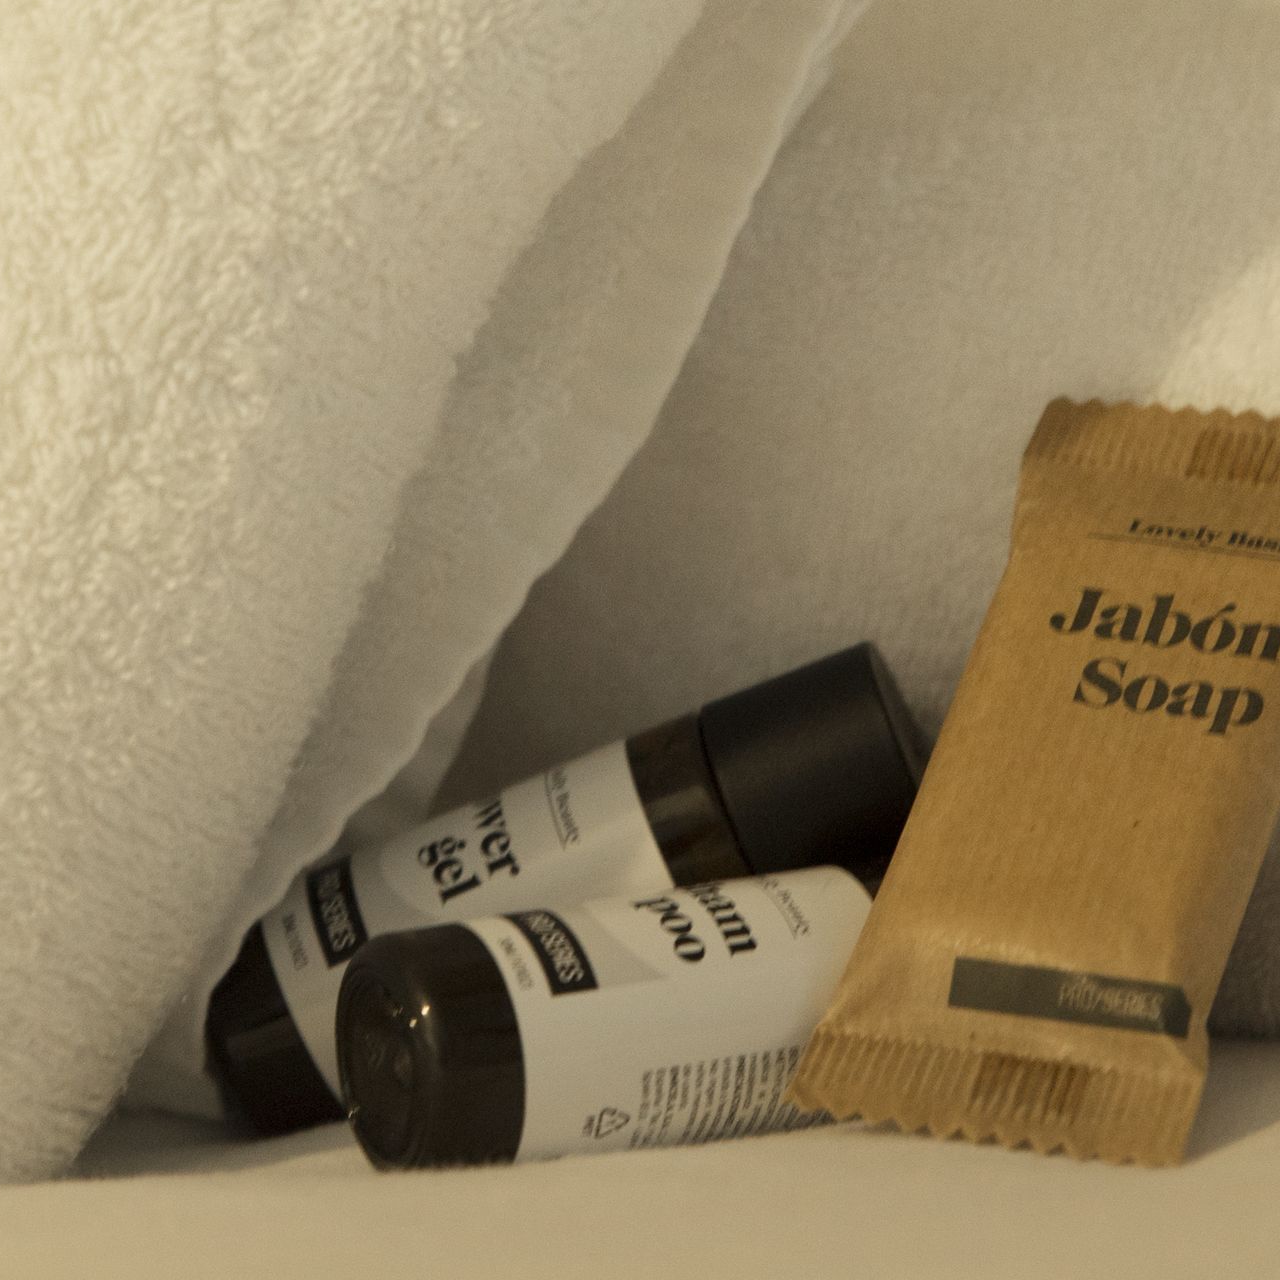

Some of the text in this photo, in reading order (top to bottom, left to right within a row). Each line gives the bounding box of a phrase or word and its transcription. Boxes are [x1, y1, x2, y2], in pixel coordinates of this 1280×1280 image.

[1128, 519, 1221, 547] Lovely
[1072, 656, 1265, 736] Soap
[417, 836, 482, 905] gel
[631, 896, 707, 963] poo
